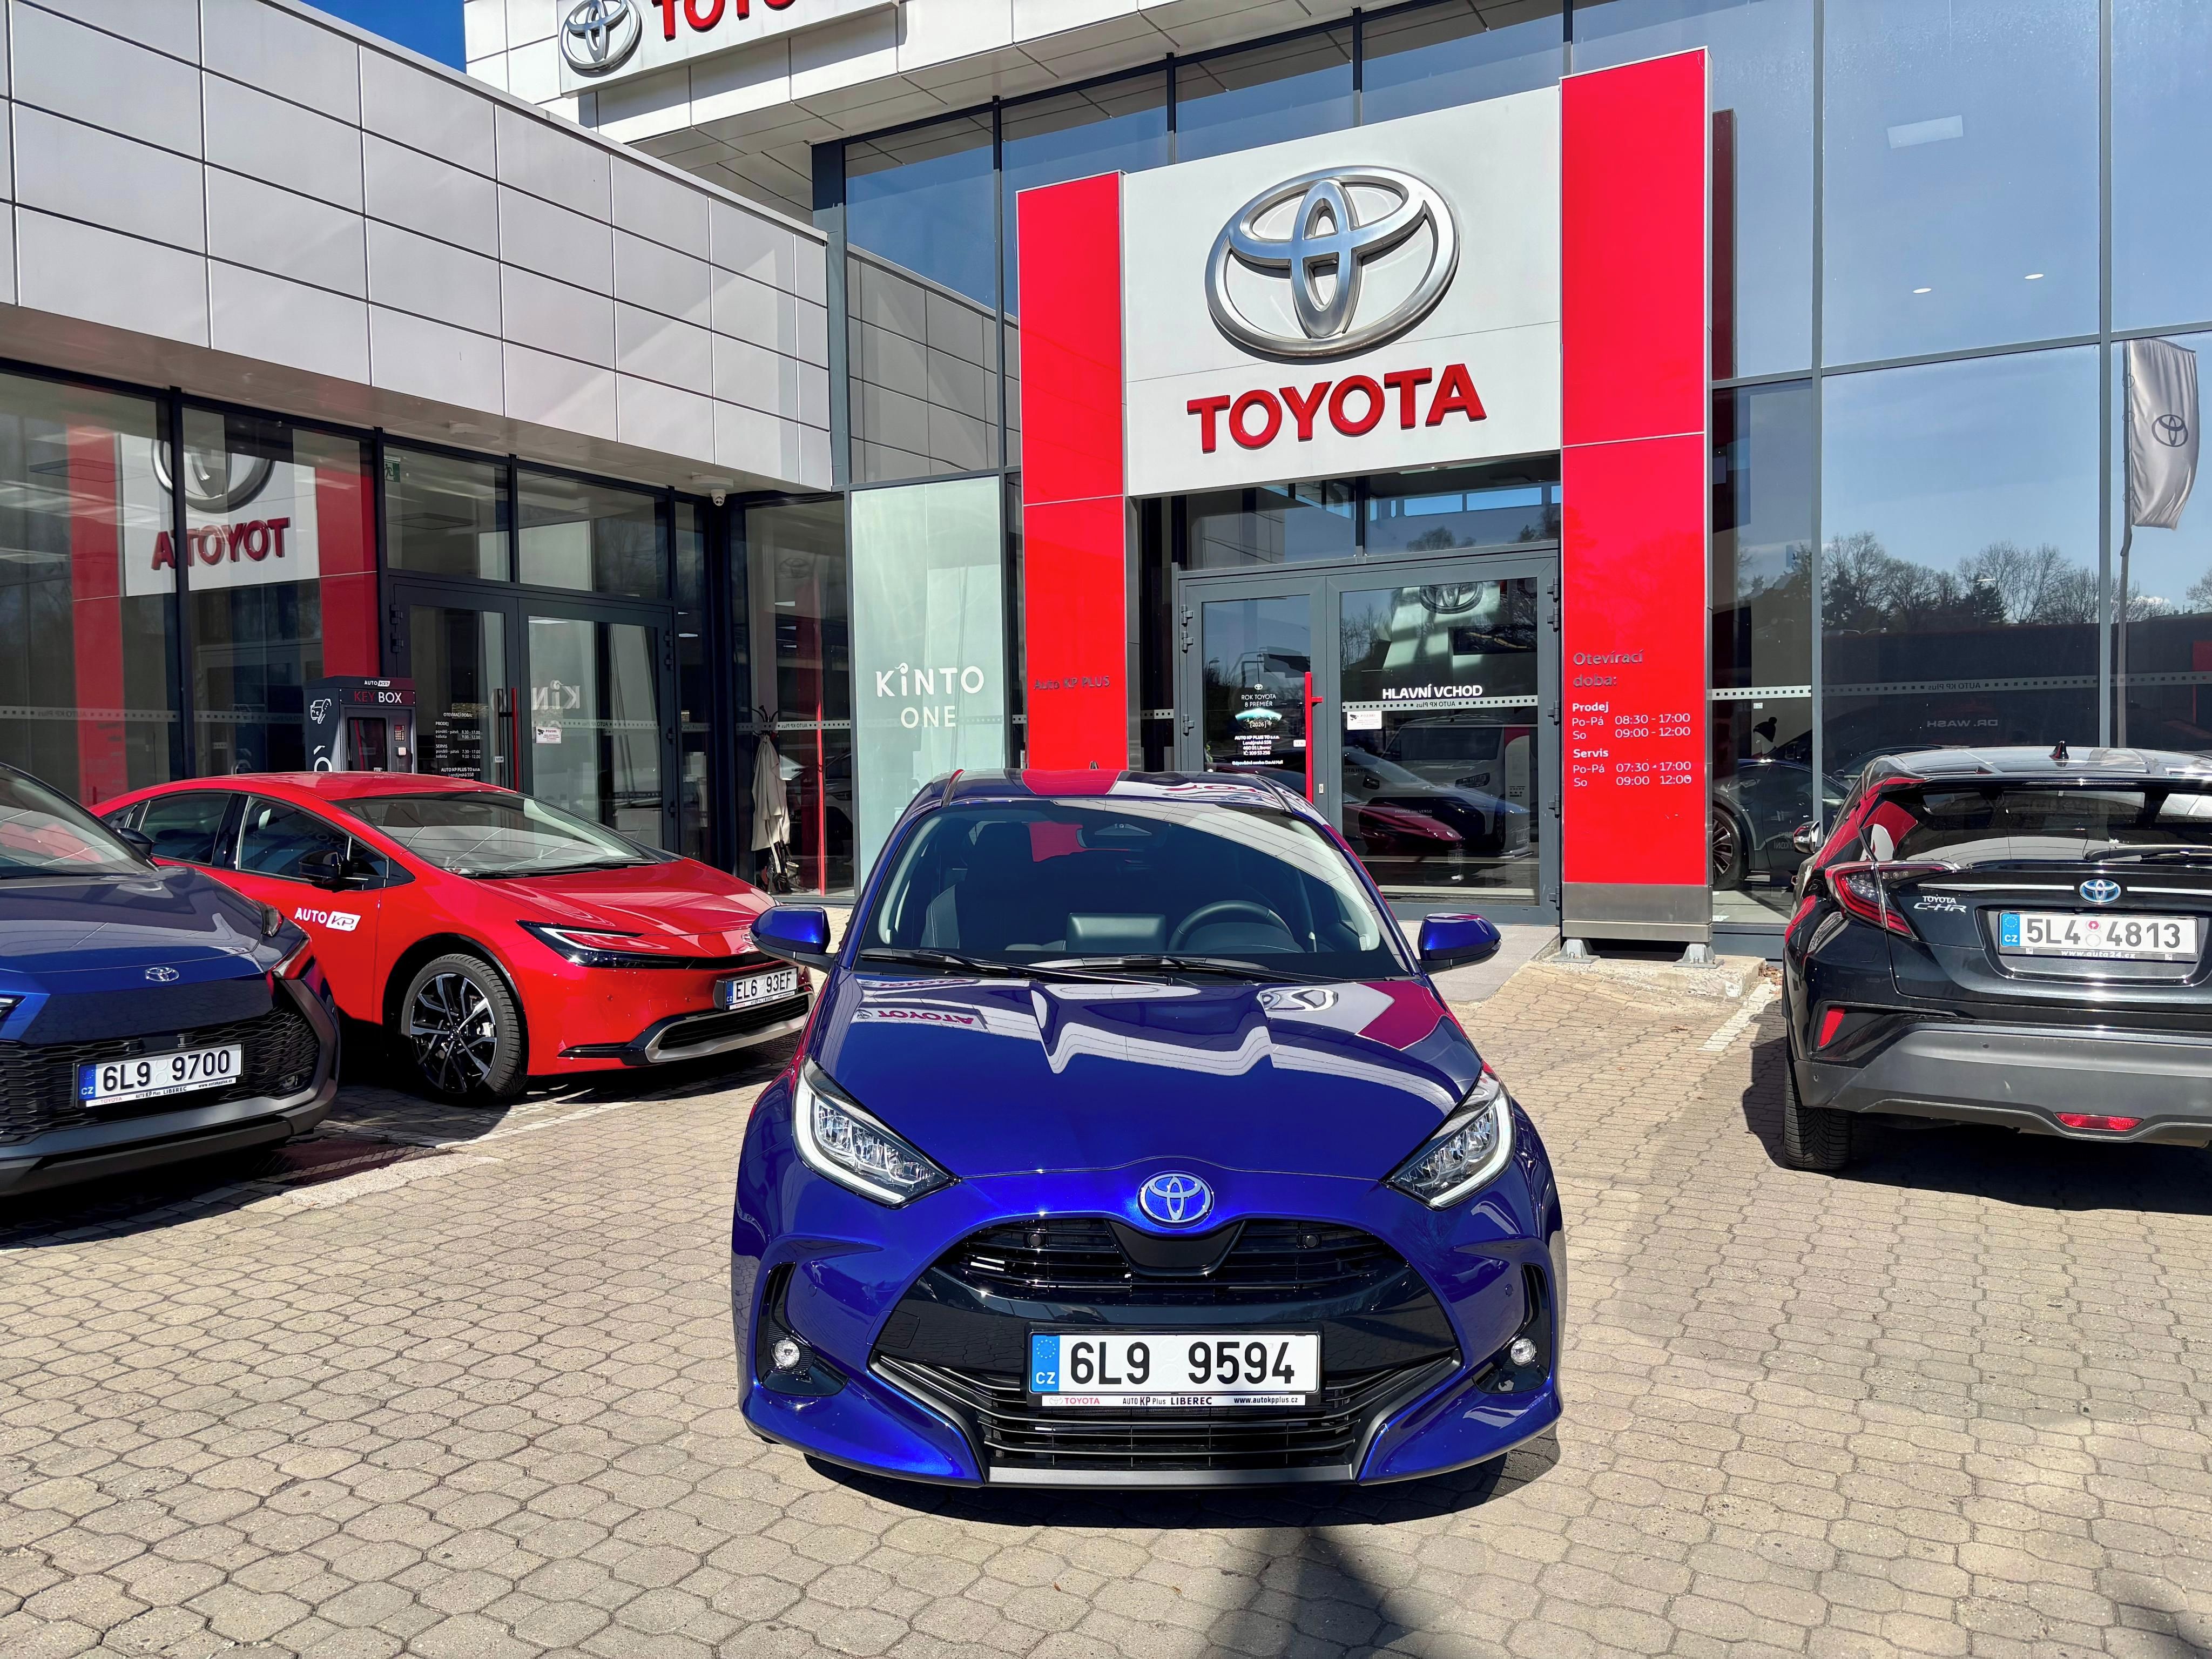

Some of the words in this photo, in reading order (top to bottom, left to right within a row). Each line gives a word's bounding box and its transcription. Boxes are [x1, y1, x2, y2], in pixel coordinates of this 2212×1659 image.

[1187, 363, 1487, 454] TOYOTA
[1573, 650, 1644, 665] Otevírací
[1063, 677, 1078, 689] KP
[1082, 676, 1110, 688] PLUS
[1573, 674, 1617, 687] doba:
[354, 691, 376, 702] KEY
[379, 692, 402, 703] BOX
[1382, 684, 1432, 699] HLAVNÍ
[1434, 685, 1483, 698] VCHOD
[1573, 702, 1609, 713] Prodej
[900, 706, 956, 729] ONE
[1572, 716, 1604, 726] Po-Pá
[1615, 715, 1648, 725] 08:30
[1658, 713, 1690, 723] 17:00
[1573, 731, 1587, 740] So
[1615, 728, 1648, 738] 09:00
[1658, 727, 1691, 737] 12:00
[1573, 748, 1609, 758] Servis
[1573, 763, 1605, 773] Po-Pá
[1616, 762, 1649, 772] 07:30
[1660, 761, 1691, 771] 17:00
[1574, 778, 1587, 787] So
[1616, 776, 1649, 785] 09:00
[1660, 775, 1691, 785] 12:00
[1922, 896, 1957, 904] TOYOTA
[1913, 902, 1967, 913] C-HR
[294, 907, 327, 924] AUTO
[2004, 935, 2018, 943] CZ
[2027, 919, 2081, 945] 5L4
[2107, 921, 2180, 948] 4813
[2061, 950, 2136, 959] www.auta24.cz
[736, 979, 757, 1000] EL6
[766, 971, 792, 993] 93EF
[103, 1061, 151, 1091] 6L9
[172, 1050, 230, 1081] 9700
[82, 1087, 93, 1095] CZ
[163, 1086, 187, 1095] LIBEREC
[1070, 1341, 1150, 1385] 6L9
[1188, 1341, 1294, 1384] 9594
[1036, 1372, 1055, 1385] CZ
[1064, 1397, 1100, 1405] TOYOTA
[1139, 1397, 1150, 1406] KP
[1171, 1397, 1212, 1405] LIBEREC
[1233, 1397, 1298, 1405] www.autokpplus.cz
